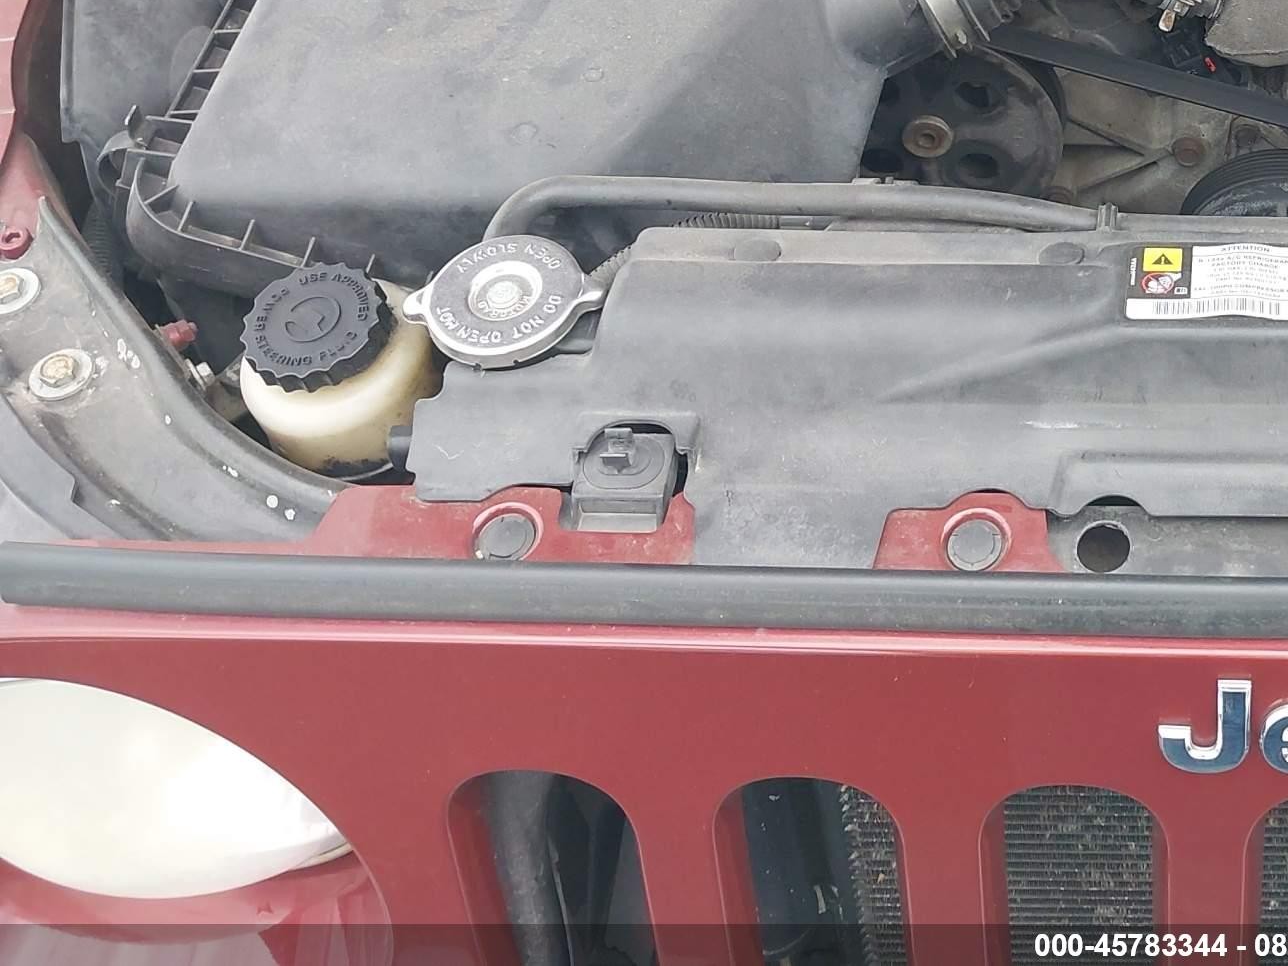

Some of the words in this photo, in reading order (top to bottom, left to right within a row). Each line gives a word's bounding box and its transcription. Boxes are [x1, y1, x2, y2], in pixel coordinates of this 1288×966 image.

[456, 242, 519, 274] SLOWLY
[523, 242, 562, 270] OPEN
[1220, 245, 1272, 253] ATTENTION
[299, 272, 328, 286] USE
[331, 273, 371, 322] APPROVED
[543, 294, 563, 314] DO
[436, 306, 460, 331] HOT
[511, 314, 545, 340] NOT
[456, 325, 504, 344] OPEN
